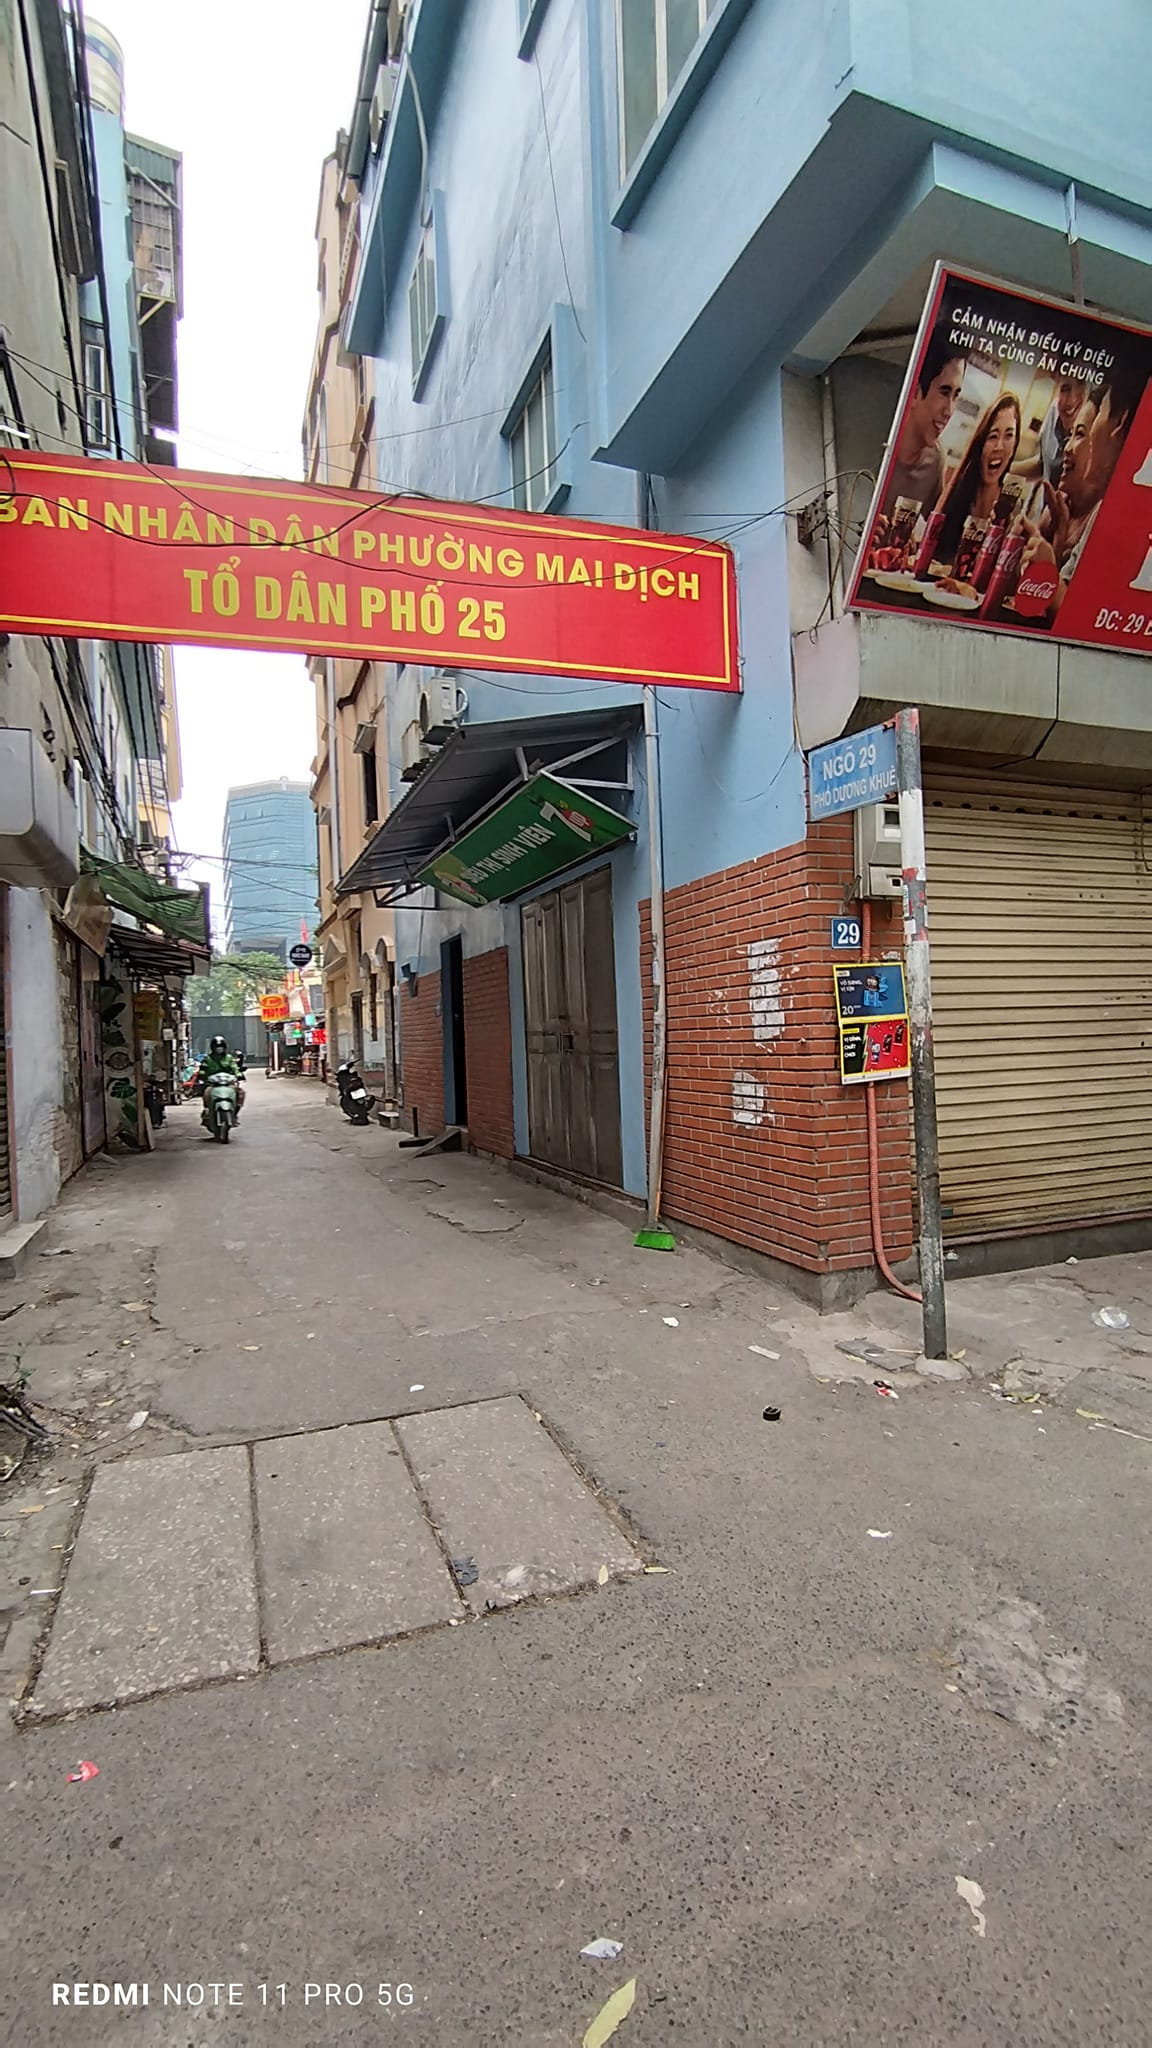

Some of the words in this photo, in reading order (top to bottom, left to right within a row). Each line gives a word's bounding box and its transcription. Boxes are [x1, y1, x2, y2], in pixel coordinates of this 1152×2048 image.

[949, 329, 974, 348] KHI
[978, 338, 994, 355] TA
[1037, 352, 1057, 372] ĂN
[1060, 362, 1104, 385] CHUNG
[951, 306, 983, 329] CẢM
[986, 319, 1026, 342] NHẬN
[1083, 349, 1115, 368] DIỆU
[0, 491, 88, 531] BAN
[104, 501, 234, 545] NHÂN
[249, 514, 339, 558] DÂN
[353, 530, 525, 577] PHƯỜNG
[536, 552, 602, 588] MAI
[614, 562, 699, 602] DỊCH
[183, 556, 240, 616] TỔ
[255, 571, 347, 626] DÂN
[360, 580, 445, 635] PHỐ
[458, 597, 506, 641] 25
[1094, 608, 1123, 631] ĐC:
[1122, 614, 1144, 635] 29
[823, 746, 855, 781] NGÕ
[859, 743, 877, 769] 29
[491, 841, 528, 865] SINH
[512, 822, 556, 848] VIÊN
[836, 922, 860, 945] 29
[841, 1004, 854, 1015] 20
